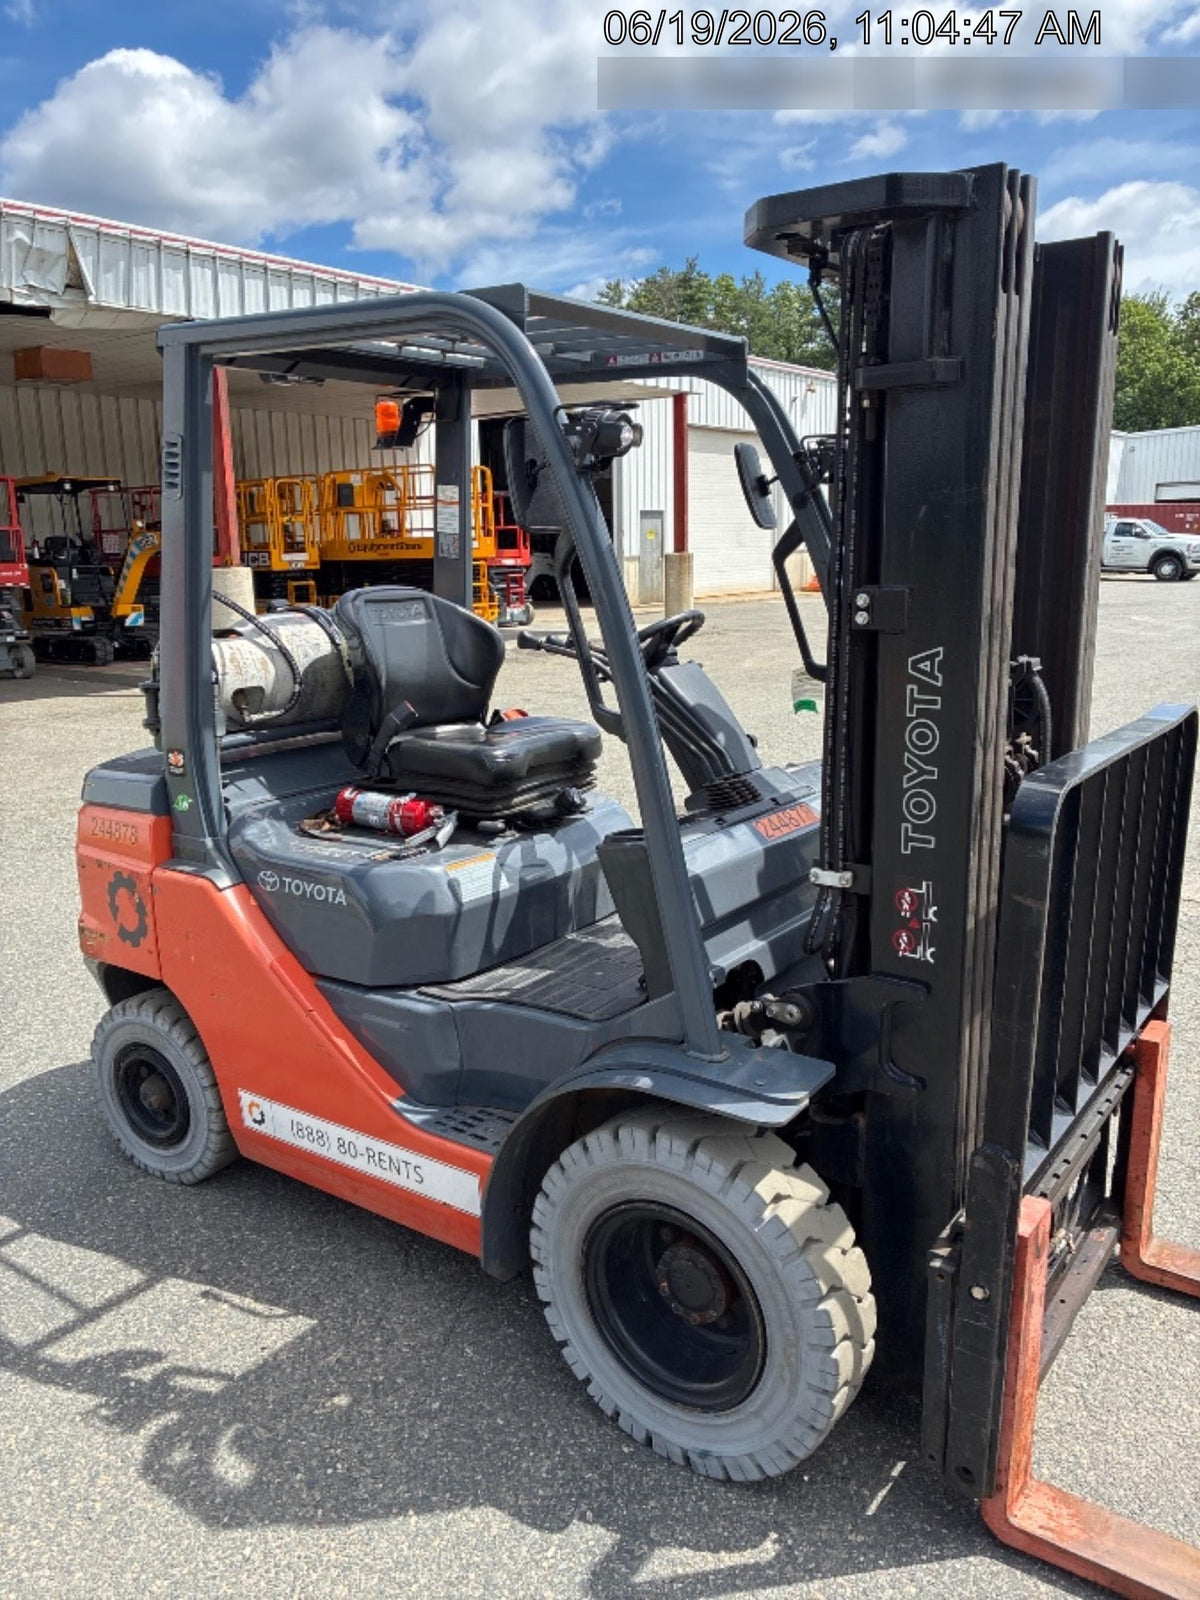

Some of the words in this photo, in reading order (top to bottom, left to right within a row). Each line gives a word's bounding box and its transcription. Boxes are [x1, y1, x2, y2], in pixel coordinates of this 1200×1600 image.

[901, 646, 943, 854] TOYOTA
[282, 877, 347, 906] TOYOTA
[290, 1119, 331, 1151] (888)
[337, 1137, 424, 1185] 80-RENTS
